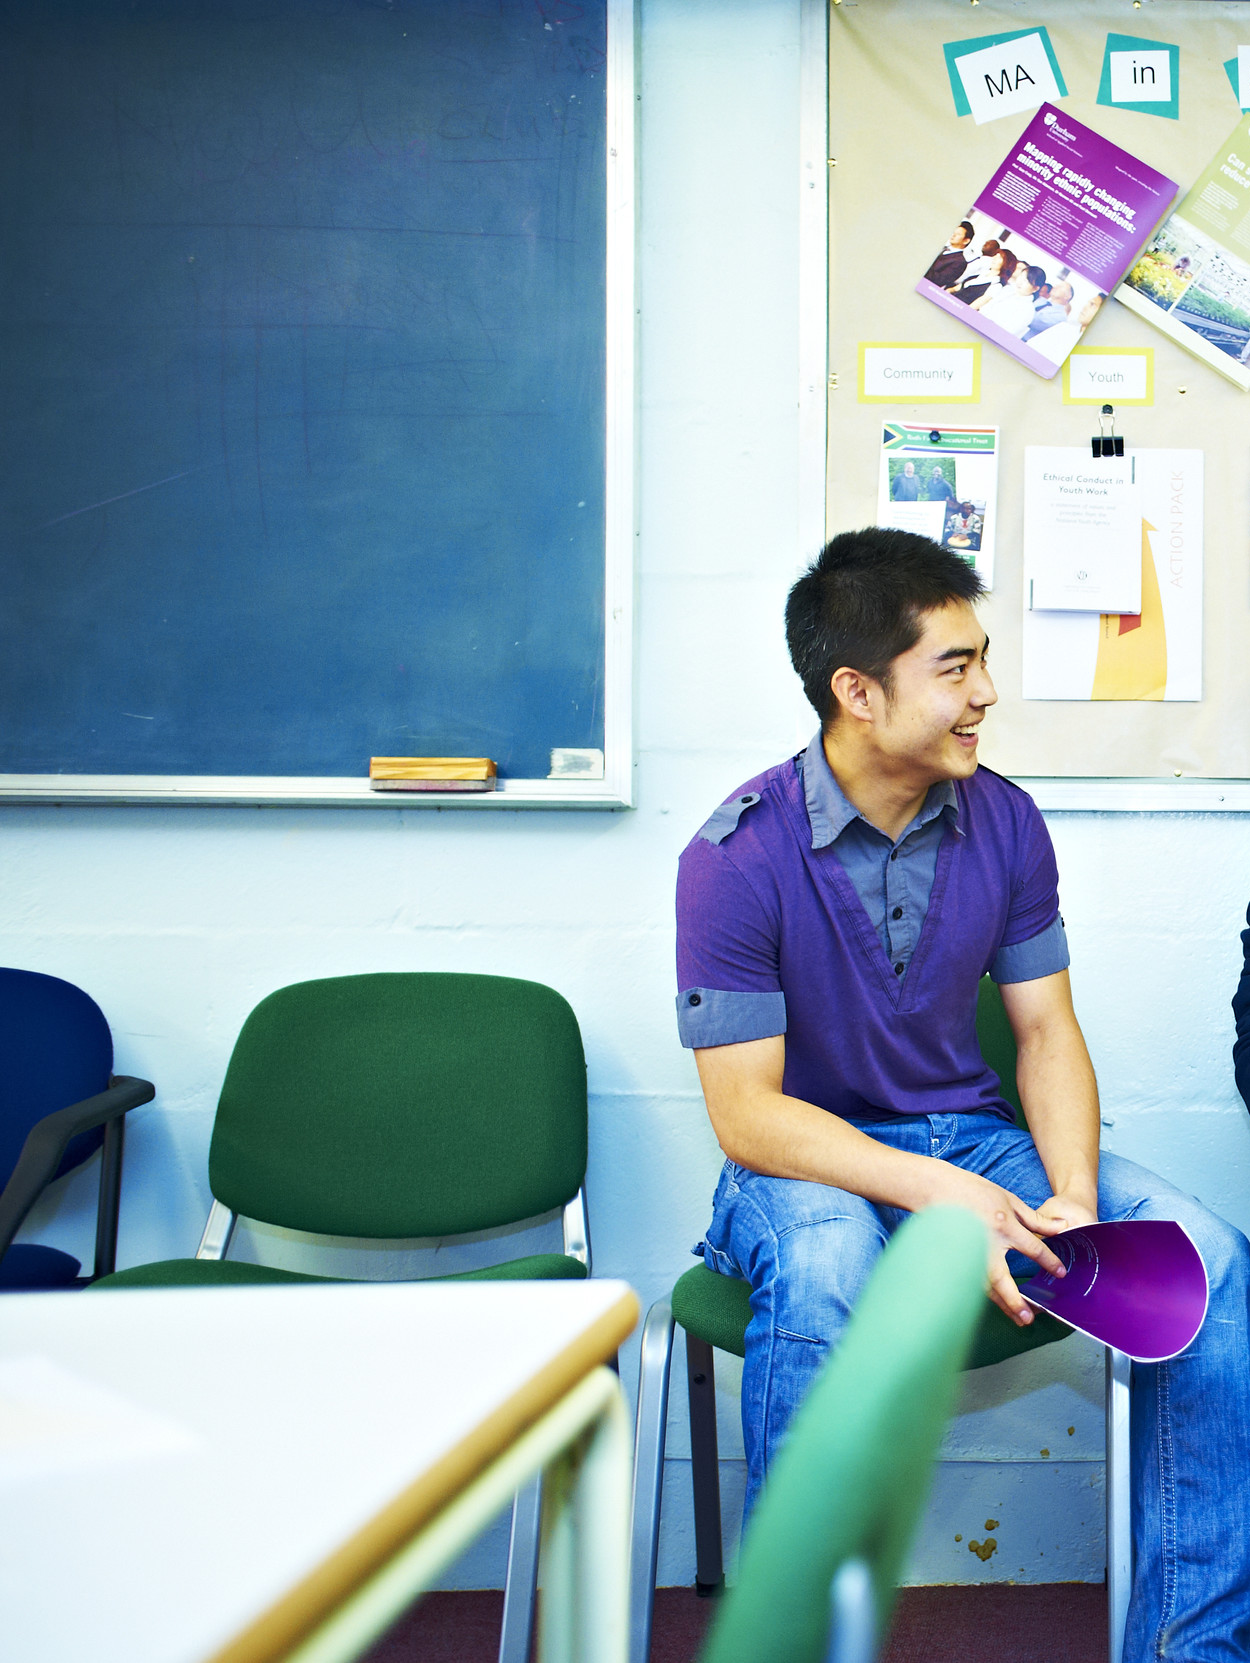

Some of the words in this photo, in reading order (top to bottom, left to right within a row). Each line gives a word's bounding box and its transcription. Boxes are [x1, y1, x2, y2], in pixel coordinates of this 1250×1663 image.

[984, 63, 1035, 98] MA
[1132, 60, 1155, 84] in
[1225, 151, 1247, 171] Can
[1015, 150, 1055, 182] minority
[1052, 173, 1084, 199] ethnic
[1079, 192, 1138, 235] populations:
[1021, 140, 1064, 174] Mapping
[1060, 165, 1096, 193] rapidly
[1091, 185, 1137, 220] changing
[882, 366, 955, 382] Community
[1088, 370, 1124, 383] Youth
[1042, 472, 1073, 481] Ethical
[1076, 475, 1112, 483] Conduct
[1058, 485, 1082, 494] Youth
[1085, 487, 1108, 496] Work
[1169, 470, 1184, 515] PACK
[1169, 521, 1184, 589] ACTION
